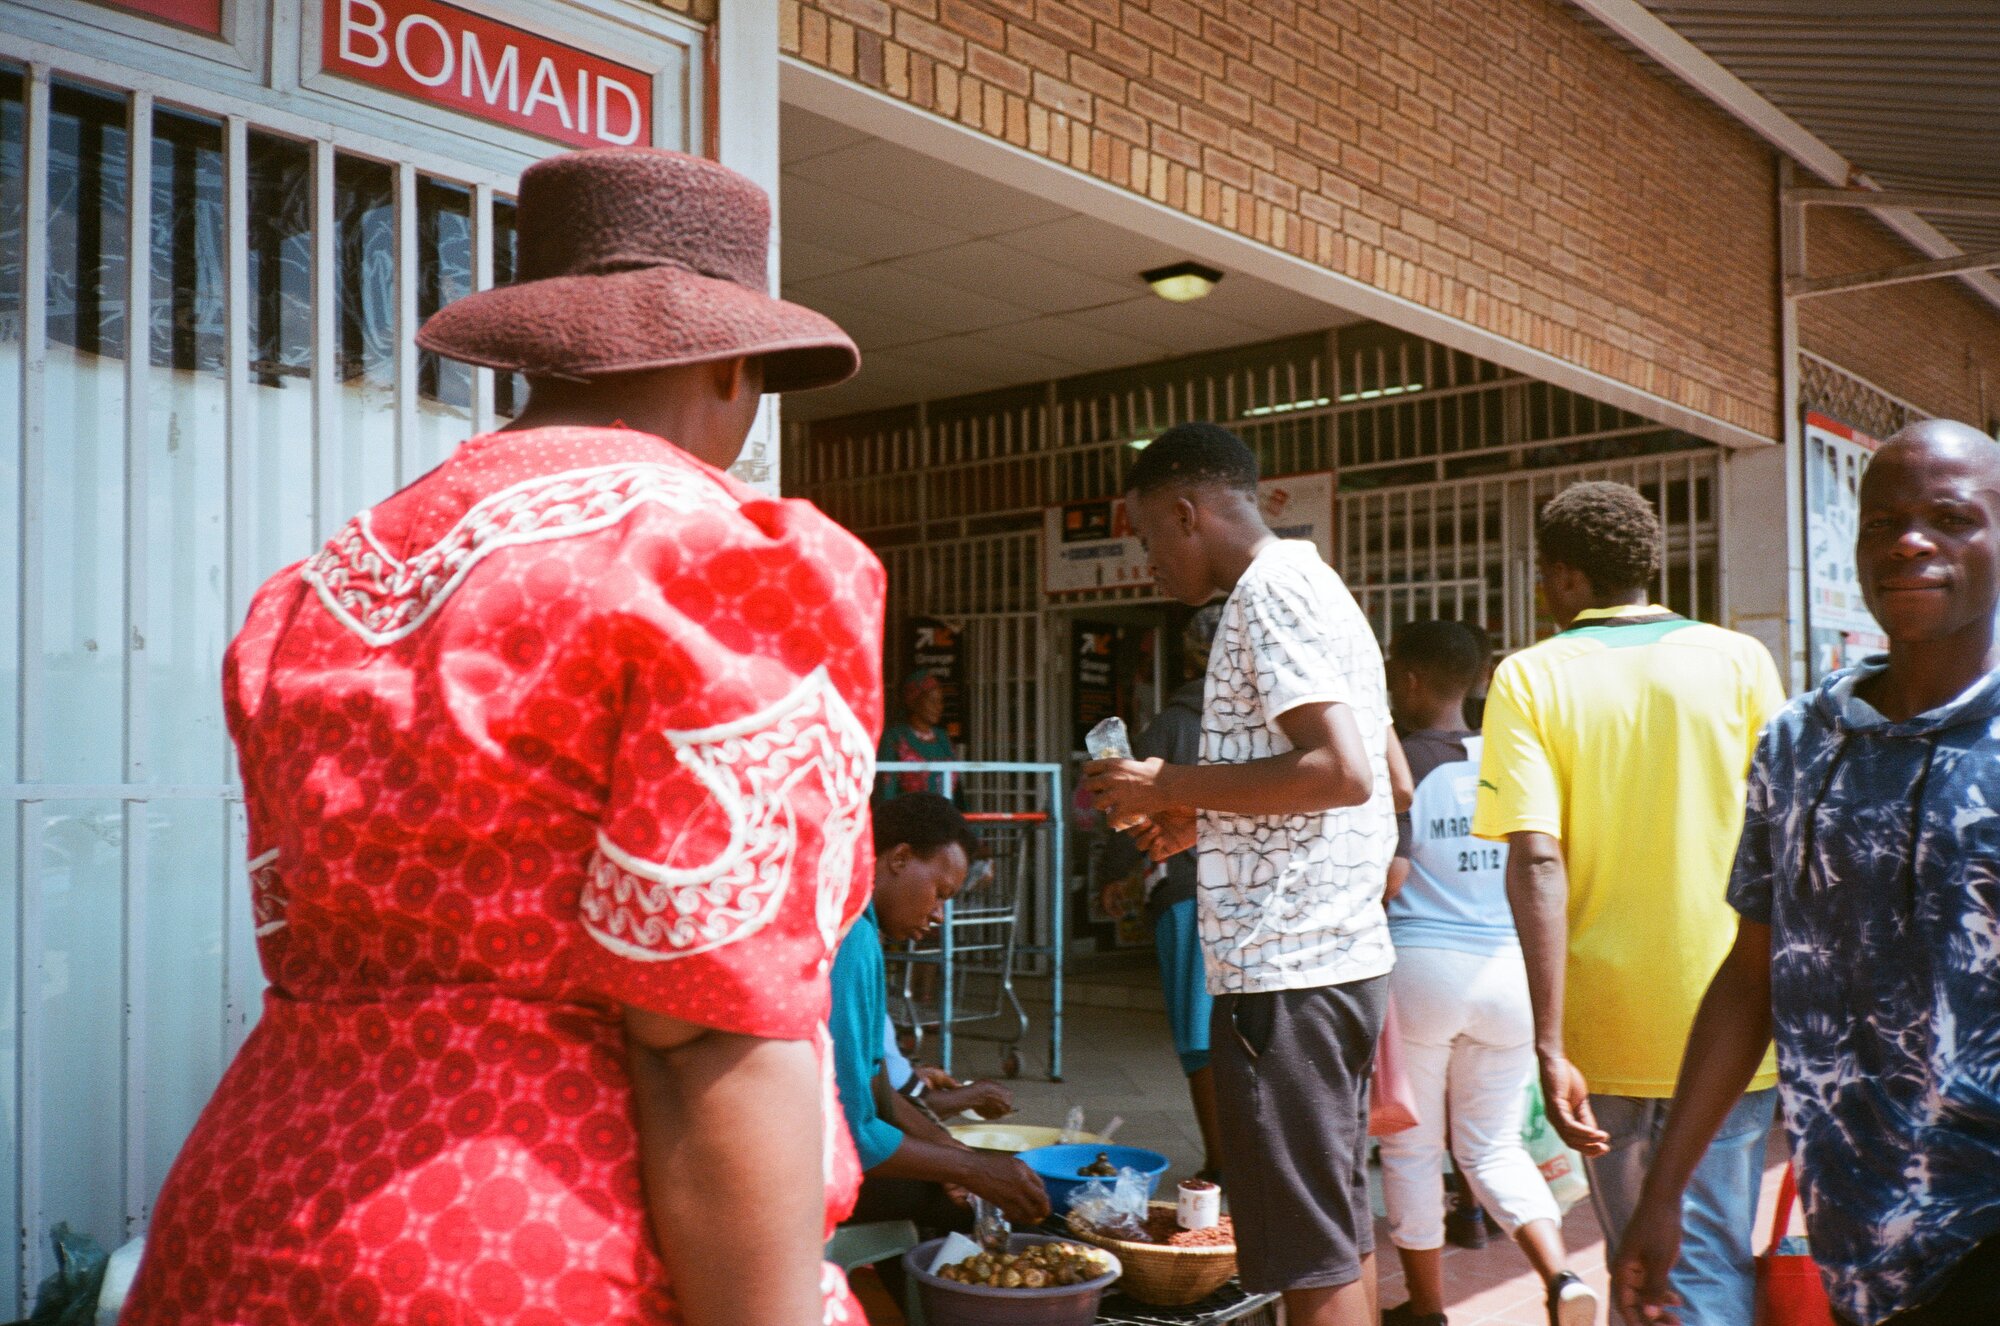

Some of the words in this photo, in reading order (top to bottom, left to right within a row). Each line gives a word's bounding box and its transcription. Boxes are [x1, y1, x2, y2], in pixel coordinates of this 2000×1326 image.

[338, 0, 642, 146] BOMAID
[1430, 816, 1472, 839] MAB
[1458, 848, 1500, 872] 2012
